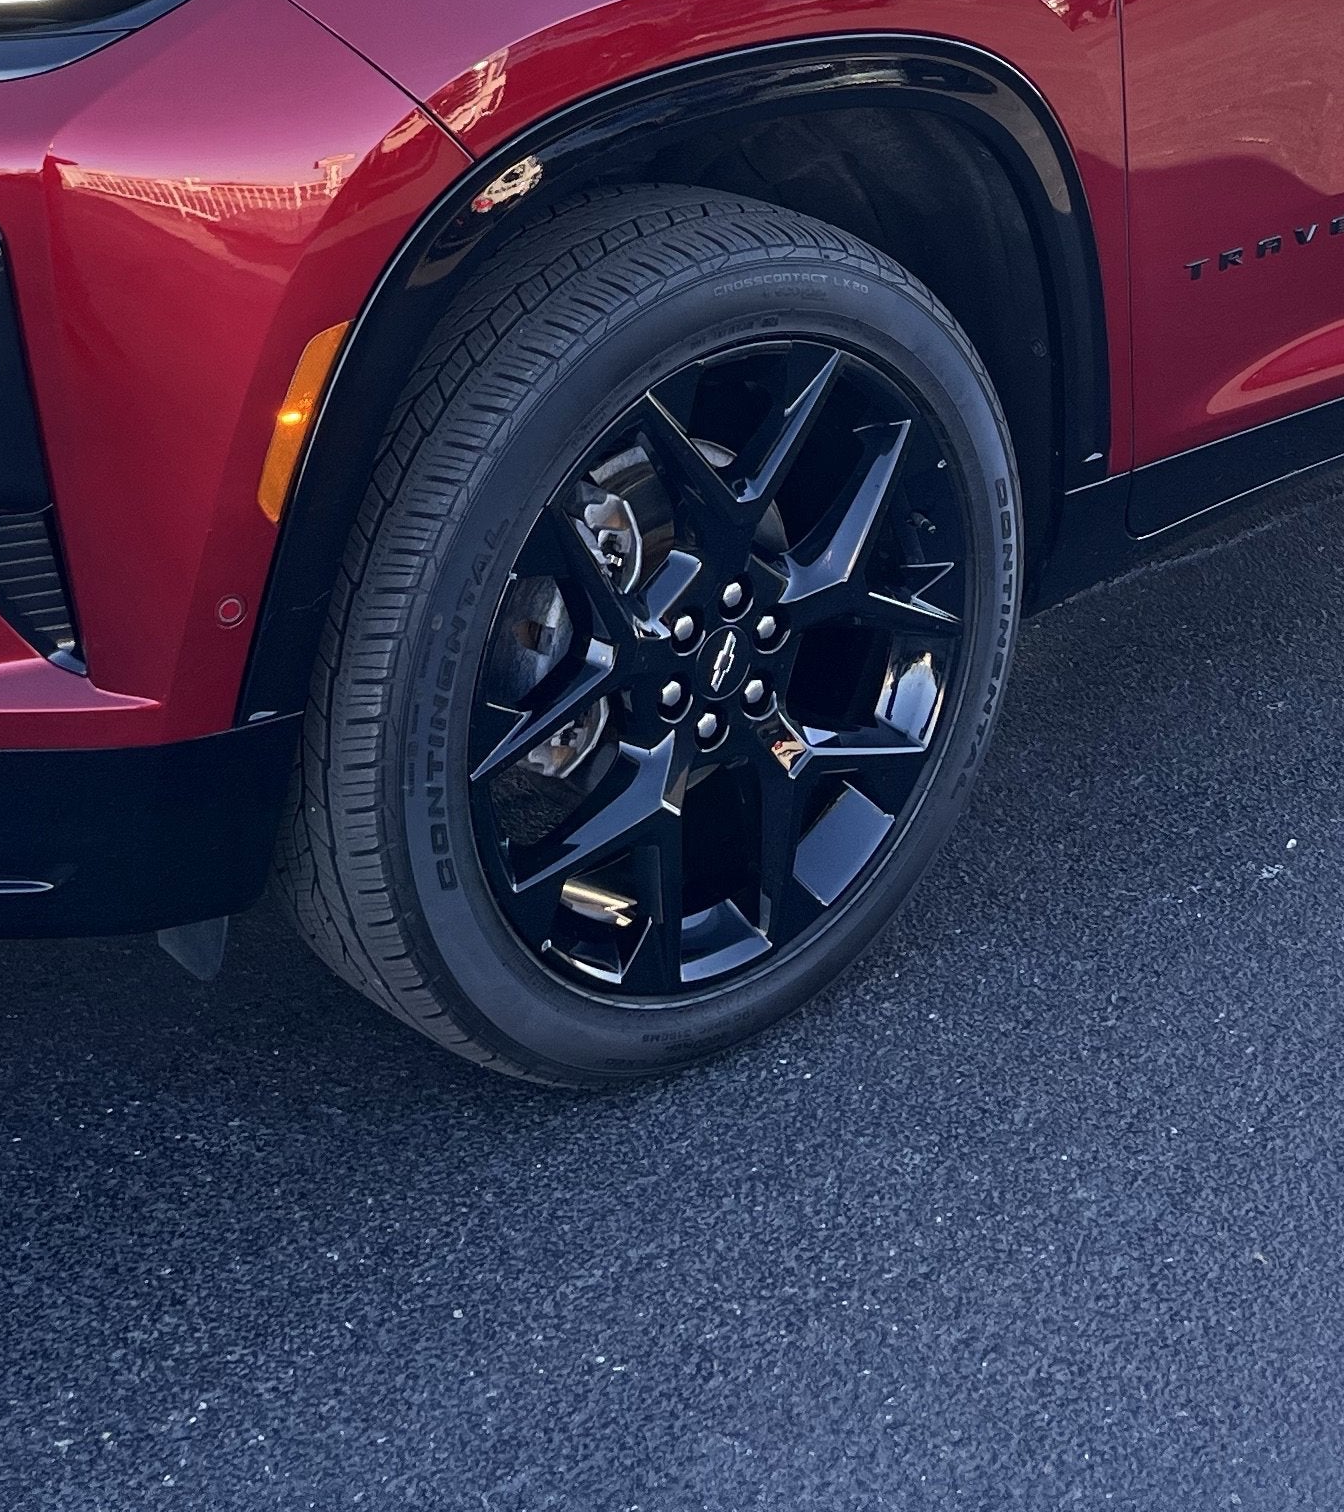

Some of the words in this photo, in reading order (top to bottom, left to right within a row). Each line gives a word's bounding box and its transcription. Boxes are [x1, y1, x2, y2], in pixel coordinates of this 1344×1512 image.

[713, 272, 829, 297] CROSSCONTACT
[833, 276, 869, 294] LX20
[427, 518, 509, 891] CONTINENTAL
